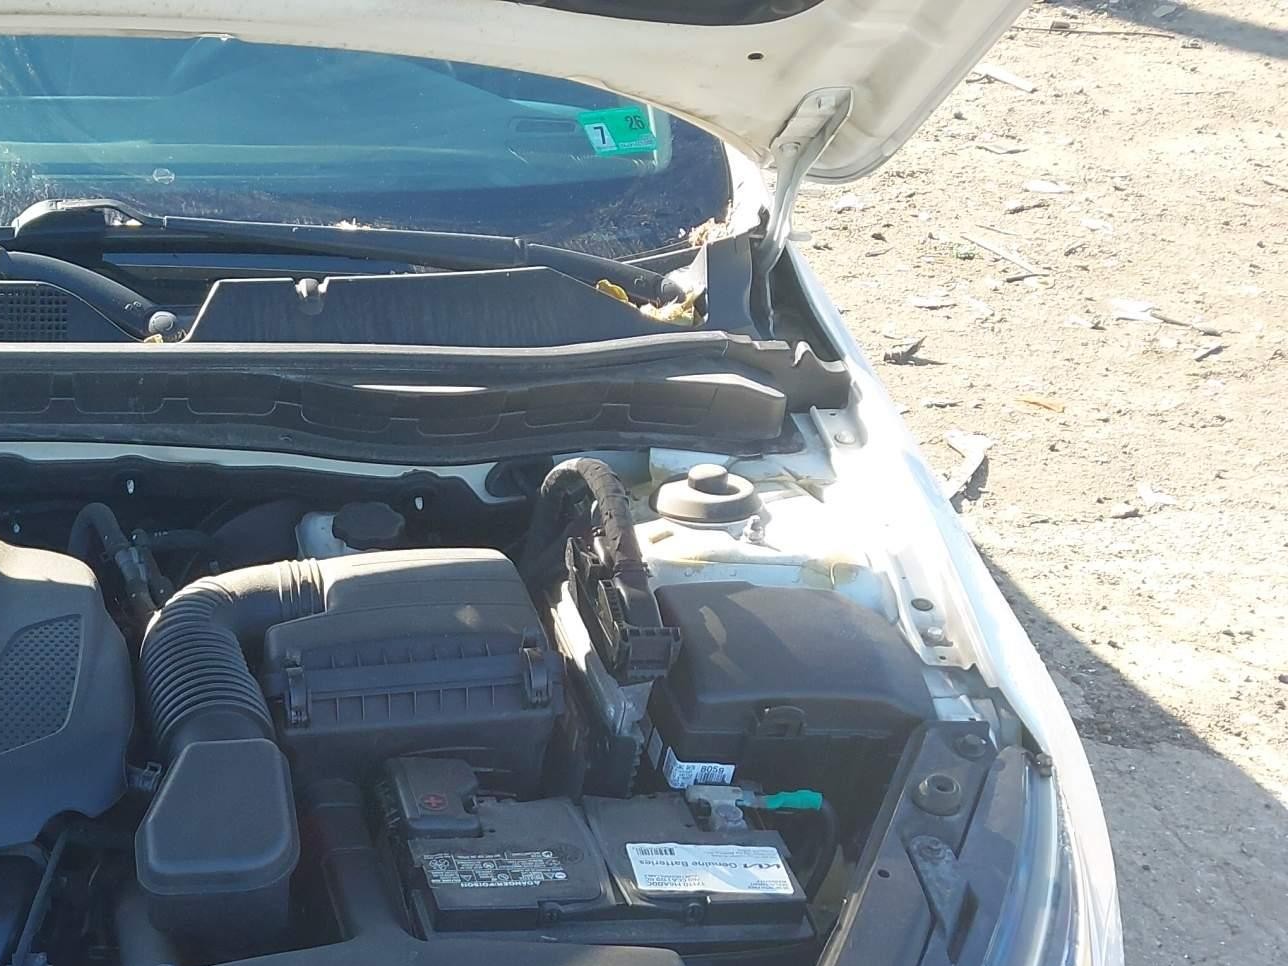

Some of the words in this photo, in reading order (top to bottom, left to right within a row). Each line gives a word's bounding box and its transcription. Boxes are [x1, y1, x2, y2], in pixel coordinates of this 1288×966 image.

[593, 126, 606, 144] 7
[639, 859, 688, 868] Batteries
[692, 860, 737, 869] Genuine
